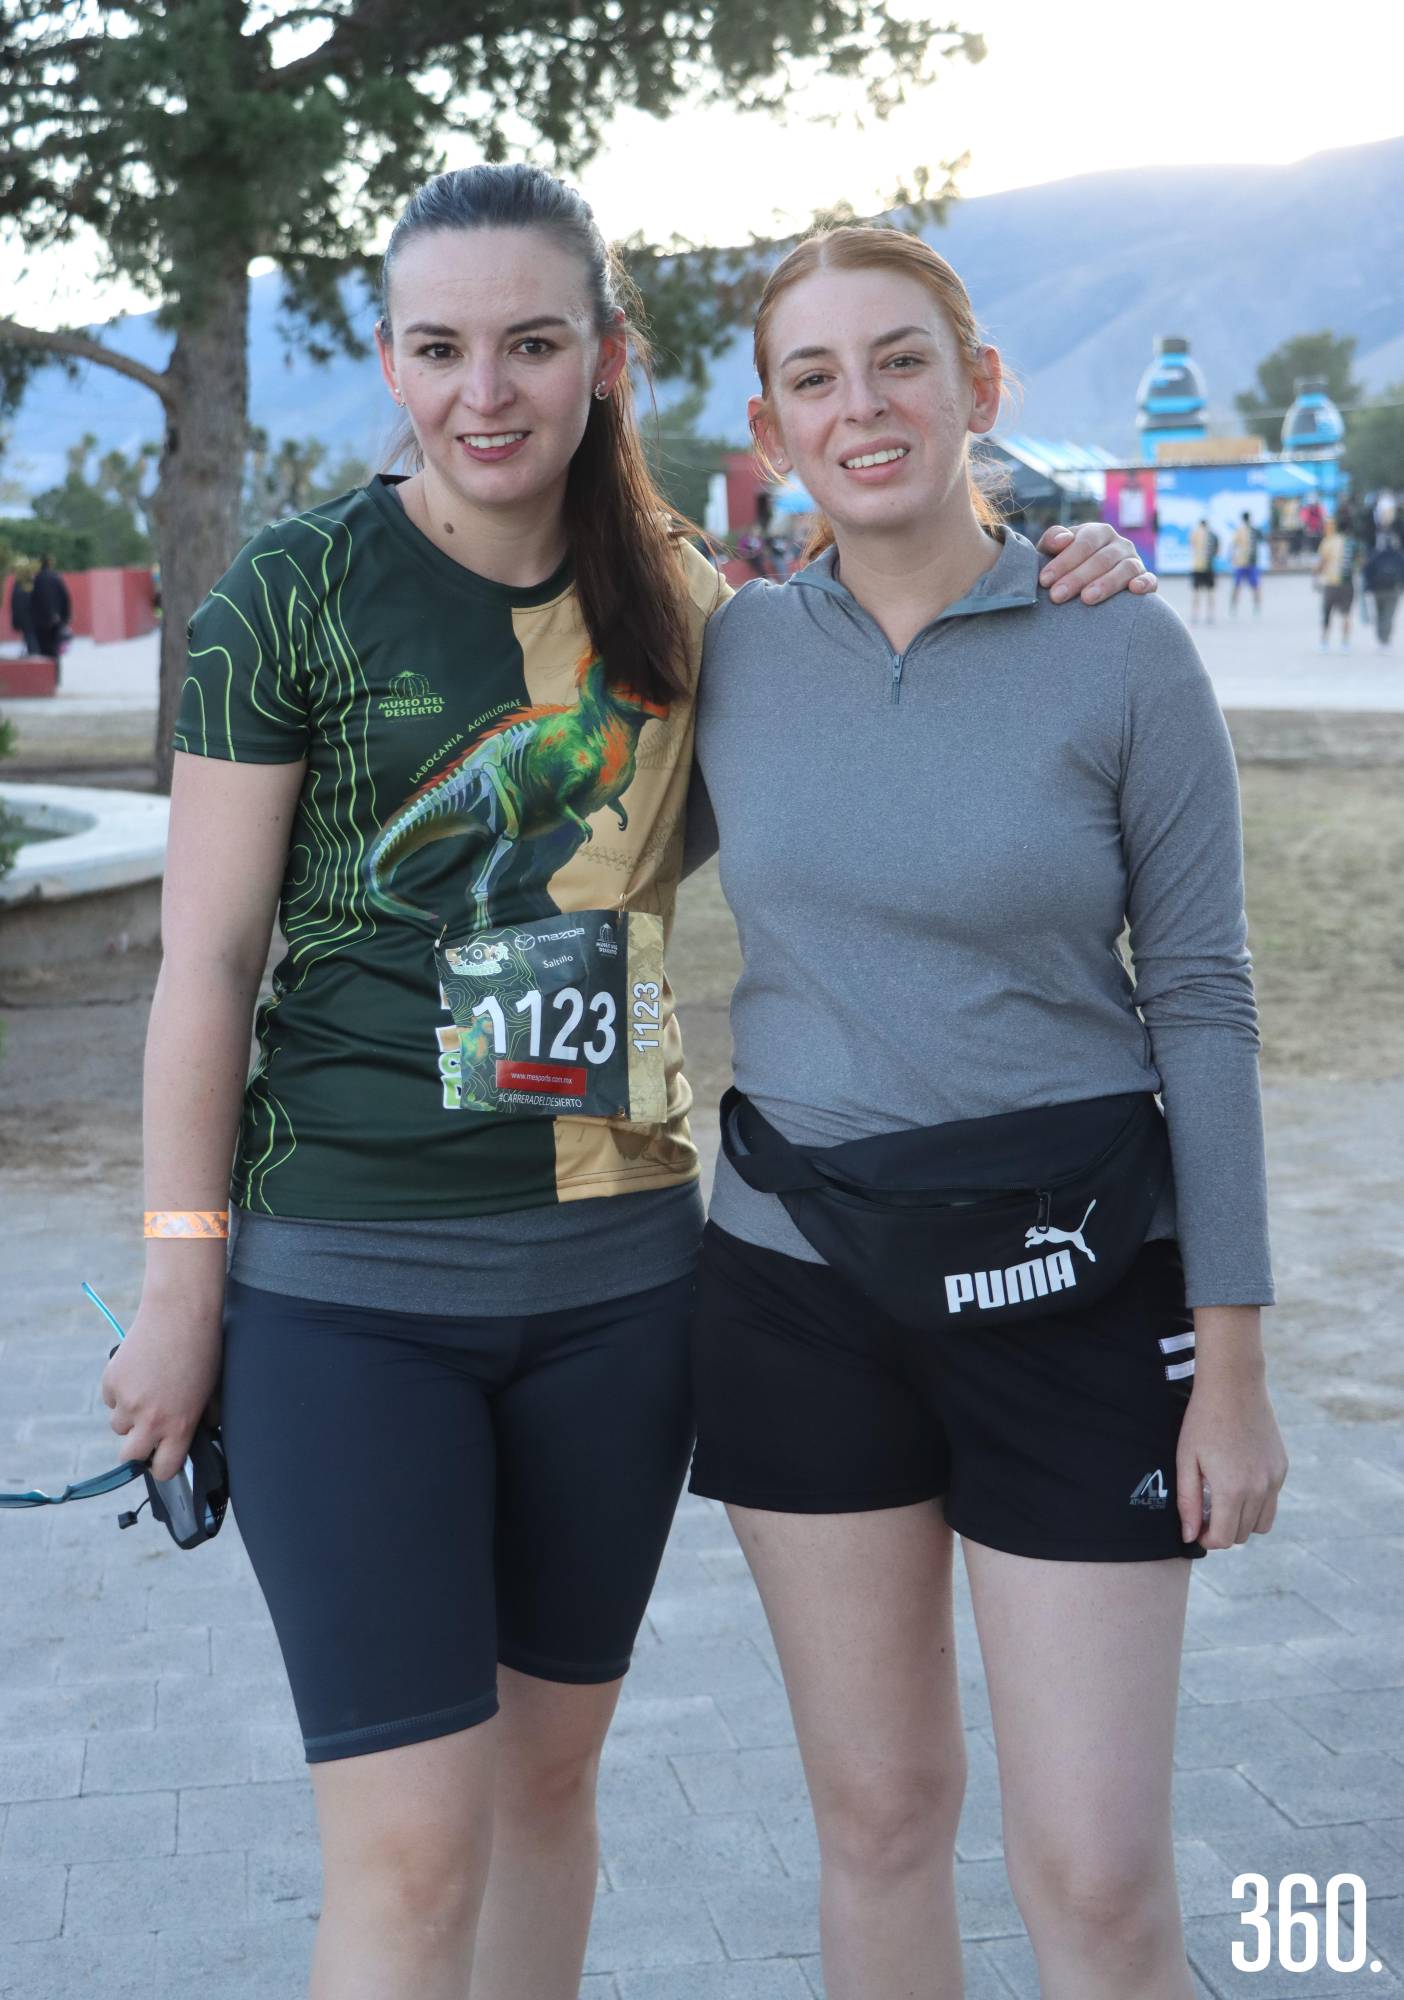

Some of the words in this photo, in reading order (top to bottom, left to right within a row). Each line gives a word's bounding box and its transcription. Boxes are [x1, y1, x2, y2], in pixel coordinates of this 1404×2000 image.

[378, 699, 420, 710] MUSEO
[423, 697, 445, 705] DEL
[385, 705, 443, 718] DESIERTO
[409, 733, 464, 784] LABOCANIA
[542, 955, 574, 969] Saltillo
[472, 987, 616, 1065] 1123
[633, 982, 660, 1053] 1123
[498, 1092, 583, 1108] #CARRERADELDESIERTO
[944, 1249, 1076, 1313] PUMA
